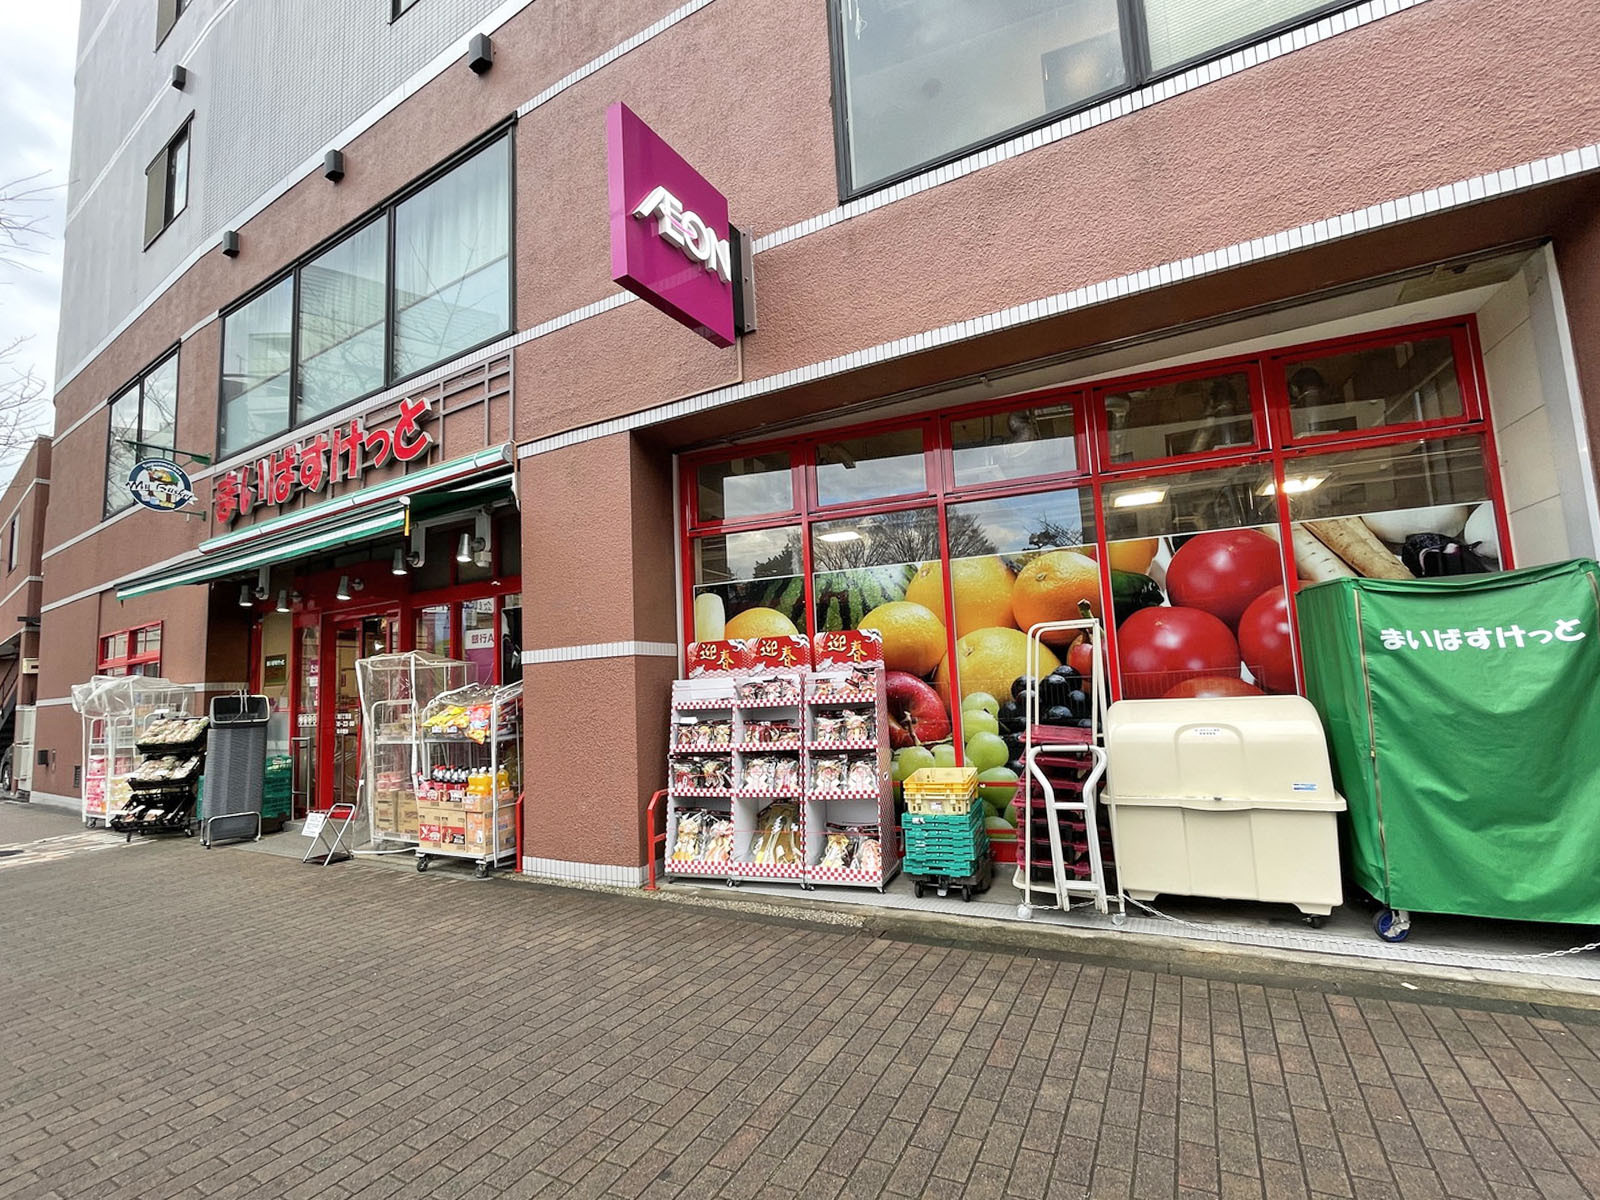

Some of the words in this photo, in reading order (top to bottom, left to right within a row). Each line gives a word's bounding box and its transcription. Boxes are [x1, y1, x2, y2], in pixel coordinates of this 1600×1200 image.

[215, 397, 433, 523] まいばすけっと
[827, 633, 868, 664] 迎春
[1380, 618, 1587, 651] まいばすけっと
[699, 643, 735, 672] 迎春
[759, 639, 798, 669] 迎春
